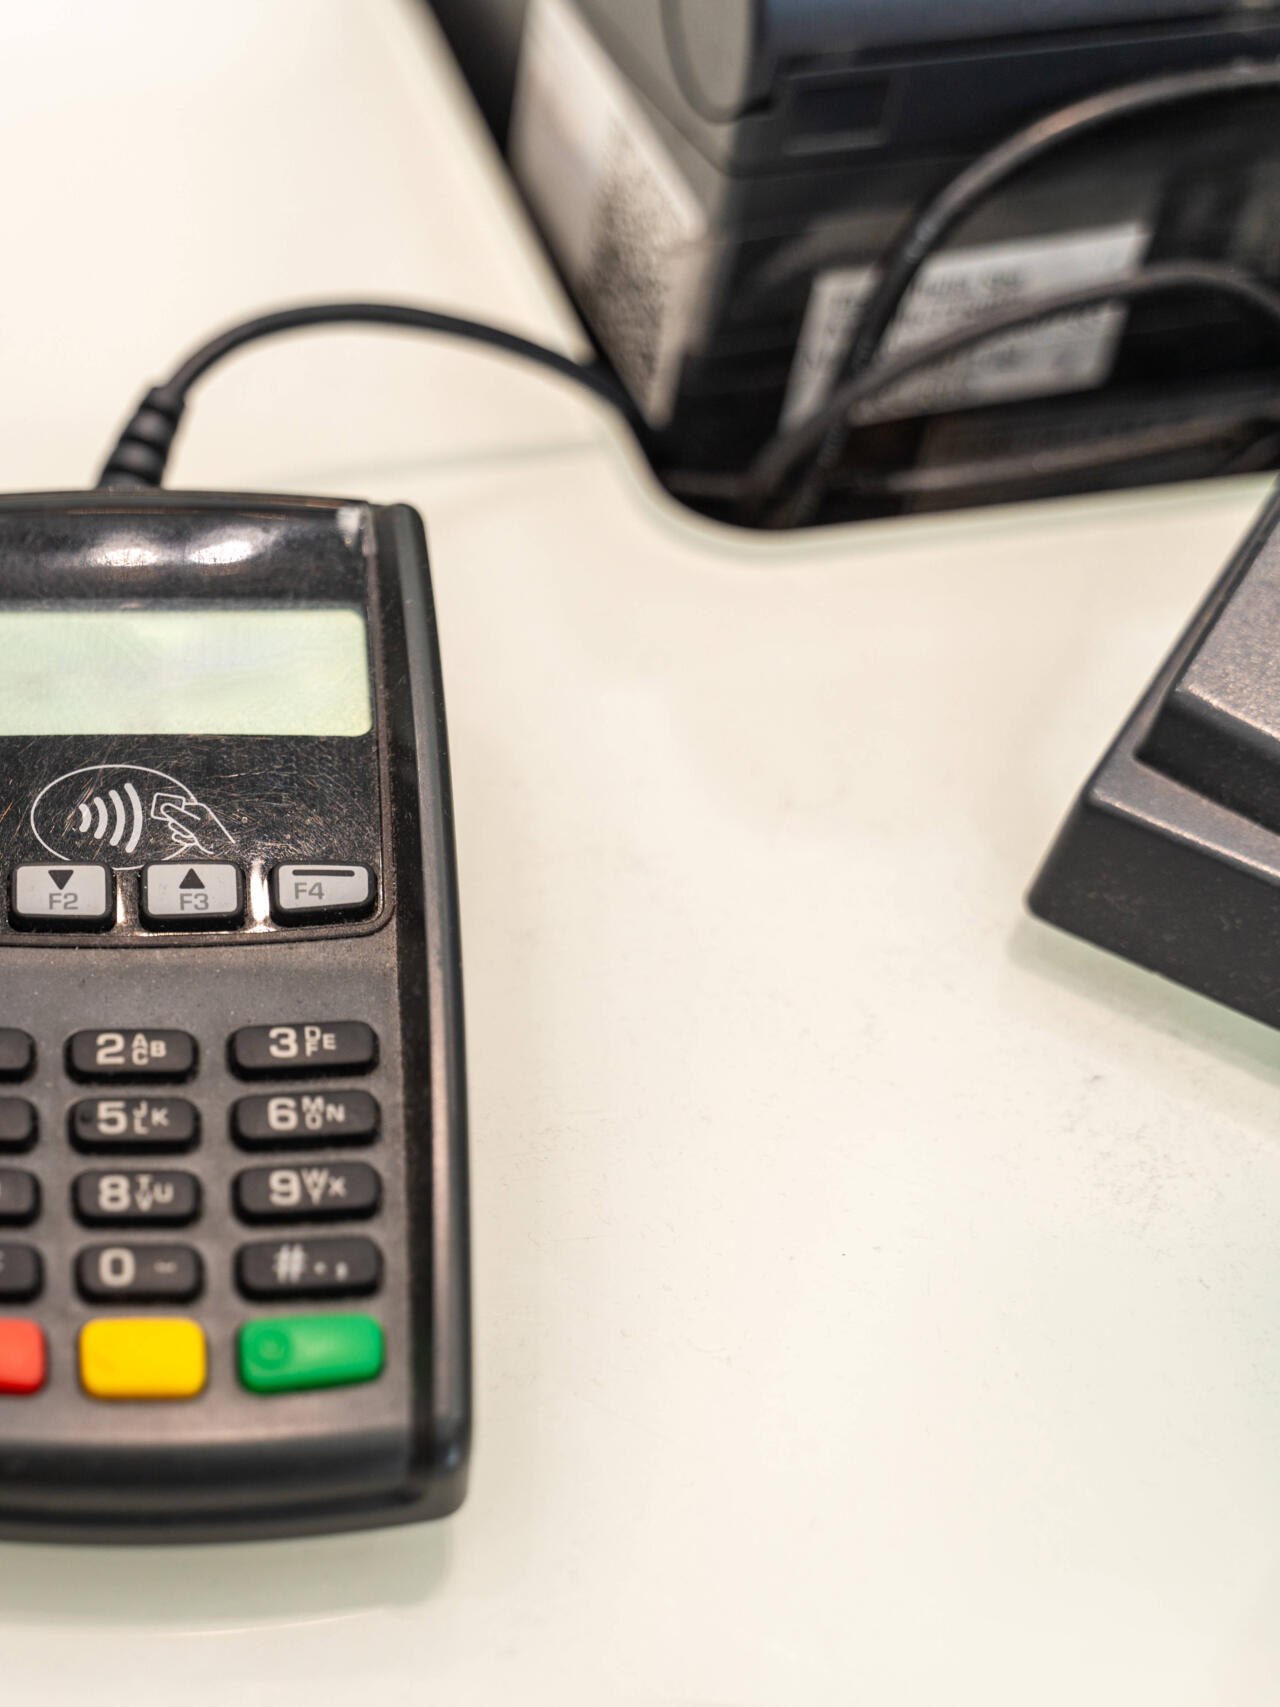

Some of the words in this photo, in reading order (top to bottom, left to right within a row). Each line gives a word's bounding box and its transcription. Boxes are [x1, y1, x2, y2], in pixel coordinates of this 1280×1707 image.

[295, 882, 324, 900] F4
[48, 892, 78, 910] F2
[180, 893, 209, 911] F3
[99, 1248, 135, 1286] 0
